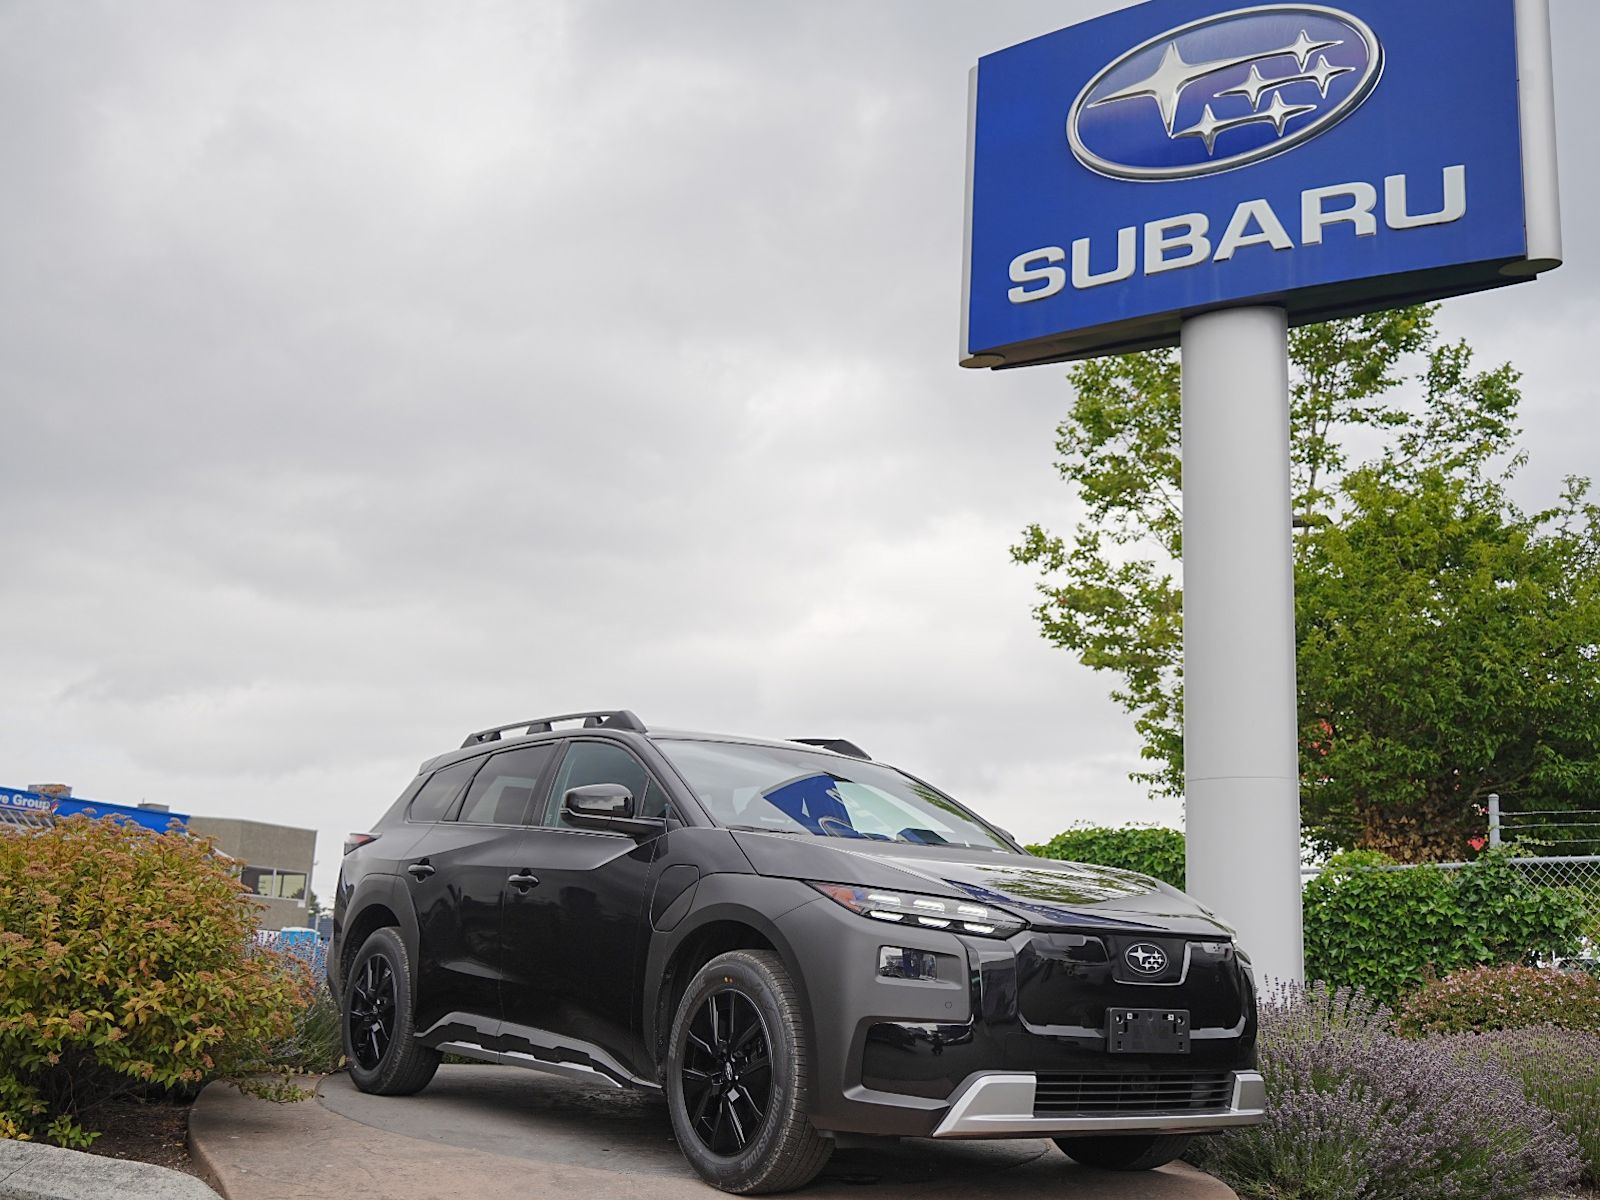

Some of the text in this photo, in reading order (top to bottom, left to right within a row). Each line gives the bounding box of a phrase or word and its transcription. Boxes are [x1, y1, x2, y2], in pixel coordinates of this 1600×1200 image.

[1008, 165, 1467, 303] SUBARU
[0, 793, 51, 810] e Group
